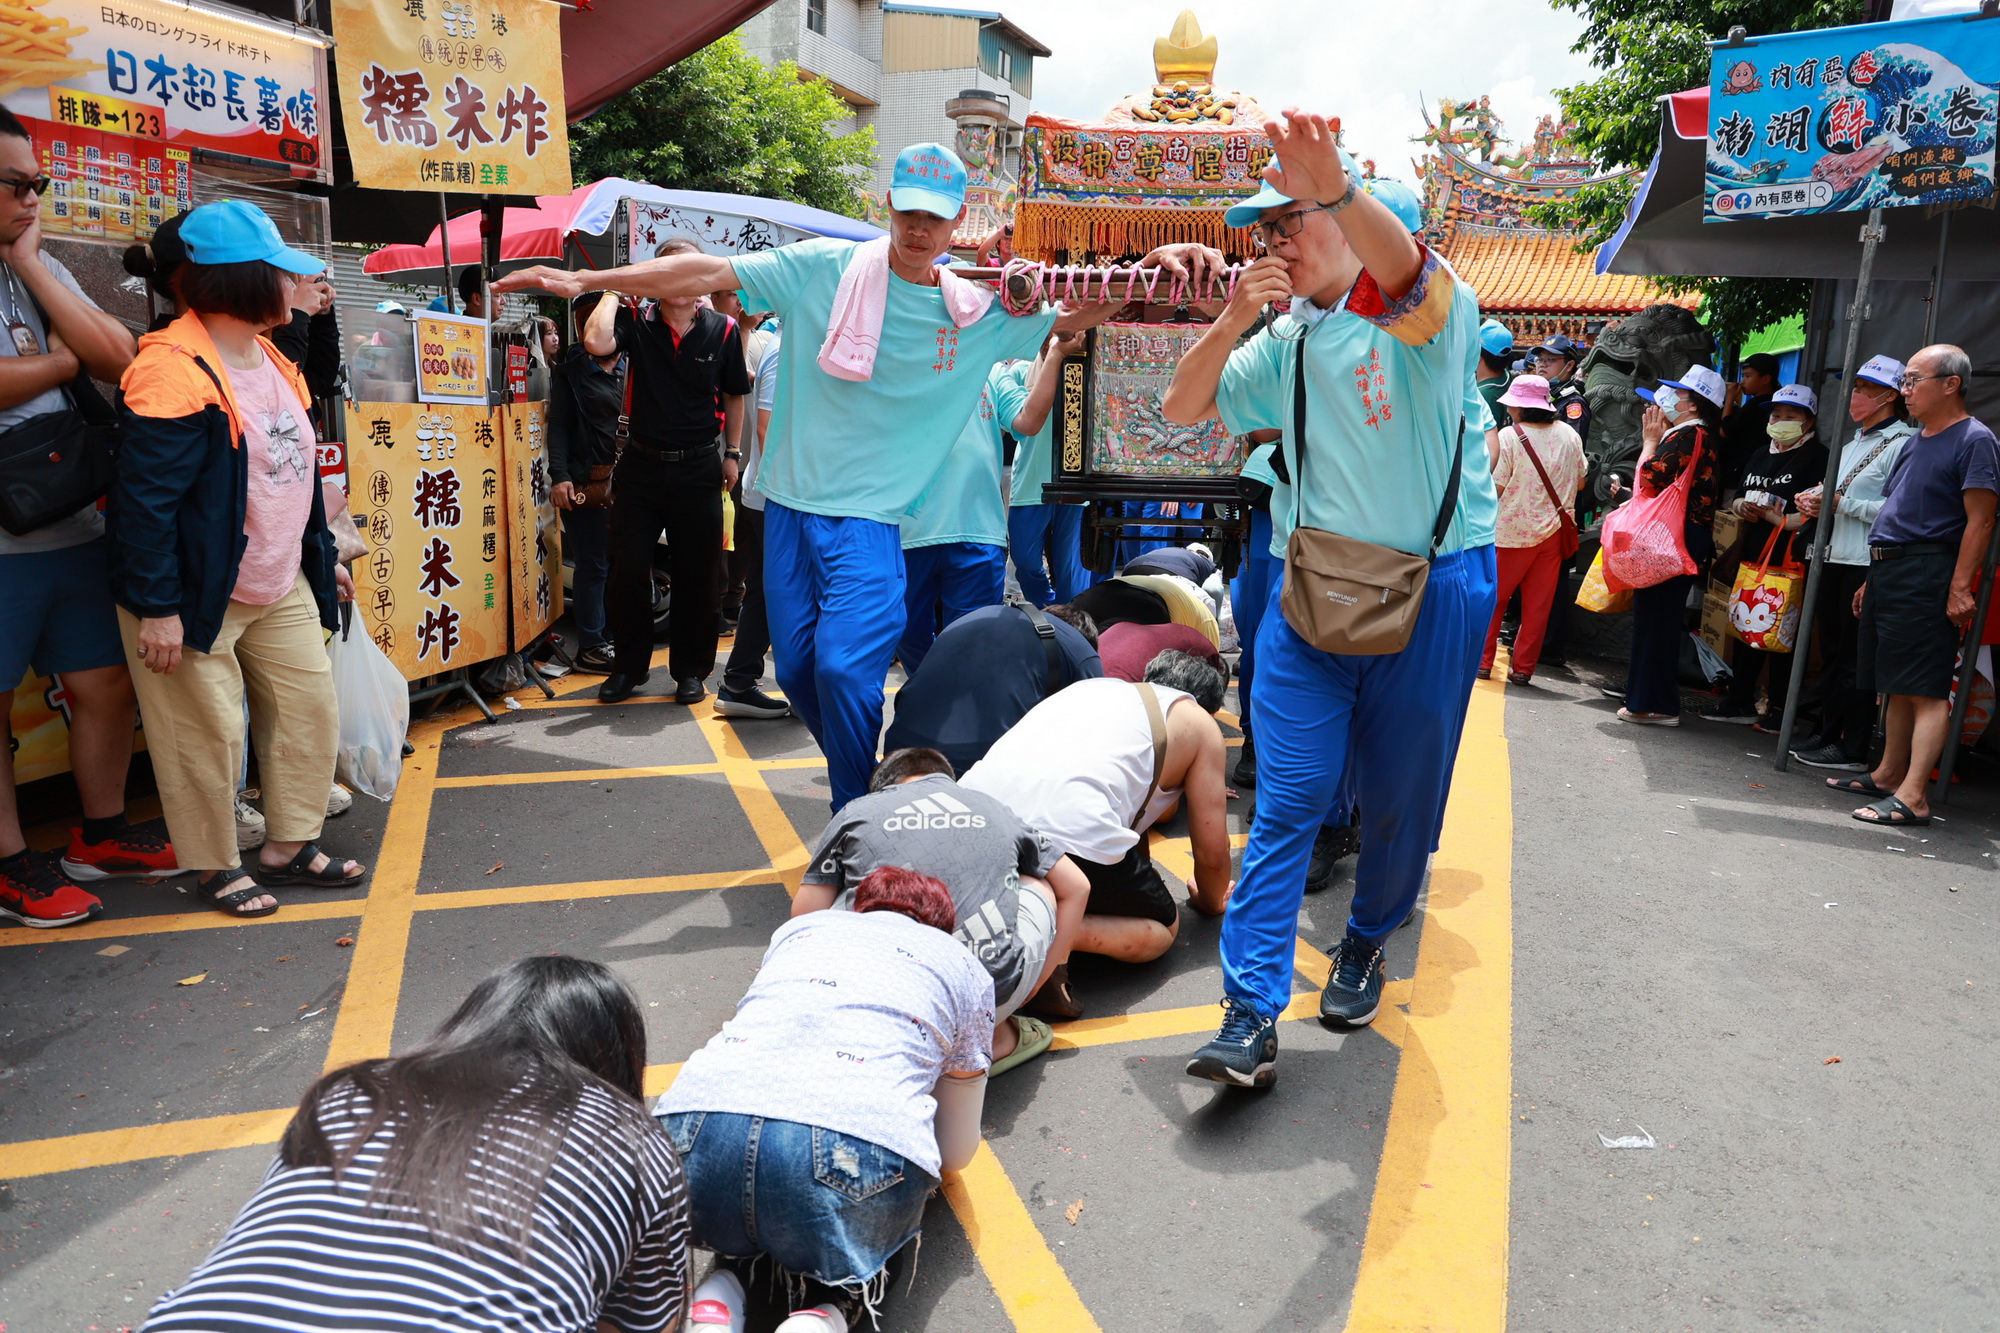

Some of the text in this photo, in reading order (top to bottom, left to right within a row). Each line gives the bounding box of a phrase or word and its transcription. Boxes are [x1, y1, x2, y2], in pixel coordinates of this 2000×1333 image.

[101, 6, 272, 64] 日本のロングフライドポテト
[491, 13, 508, 36] 港
[420, 38, 505, 70] 傳統古早味
[58, 95, 101, 128] 排隊
[106, 48, 316, 137] 日本超長薯條
[361, 64, 550, 157] 糯米炸
[1716, 85, 1988, 157] 澎湖鮮小卷
[284, 142, 316, 162] 素食
[1052, 134, 1076, 163] 投
[1886, 148, 1956, 168] 咱們漁船
[53, 141, 68, 217] 番茄紅醬
[86, 146, 101, 221] 酸甜甘梅
[118, 152, 131, 226] 日式海苔
[148, 157, 161, 228] 原味椒鹽
[176, 161, 189, 213] 黃金起司
[420, 158, 508, 186] (炸麻糬) 全素
[1901, 167, 1974, 187] 咱們故鄉
[367, 416, 495, 462] 鹿 王記 港
[482, 468, 496, 563] (炸麻糬)
[370, 473, 394, 655] 傳統古早味
[413, 467, 462, 663] 糯米炸
[483, 573, 495, 610] 全素
[883, 812, 986, 832] adidas
[808, 977, 837, 988] FILA
[836, 1050, 865, 1065] FILA
